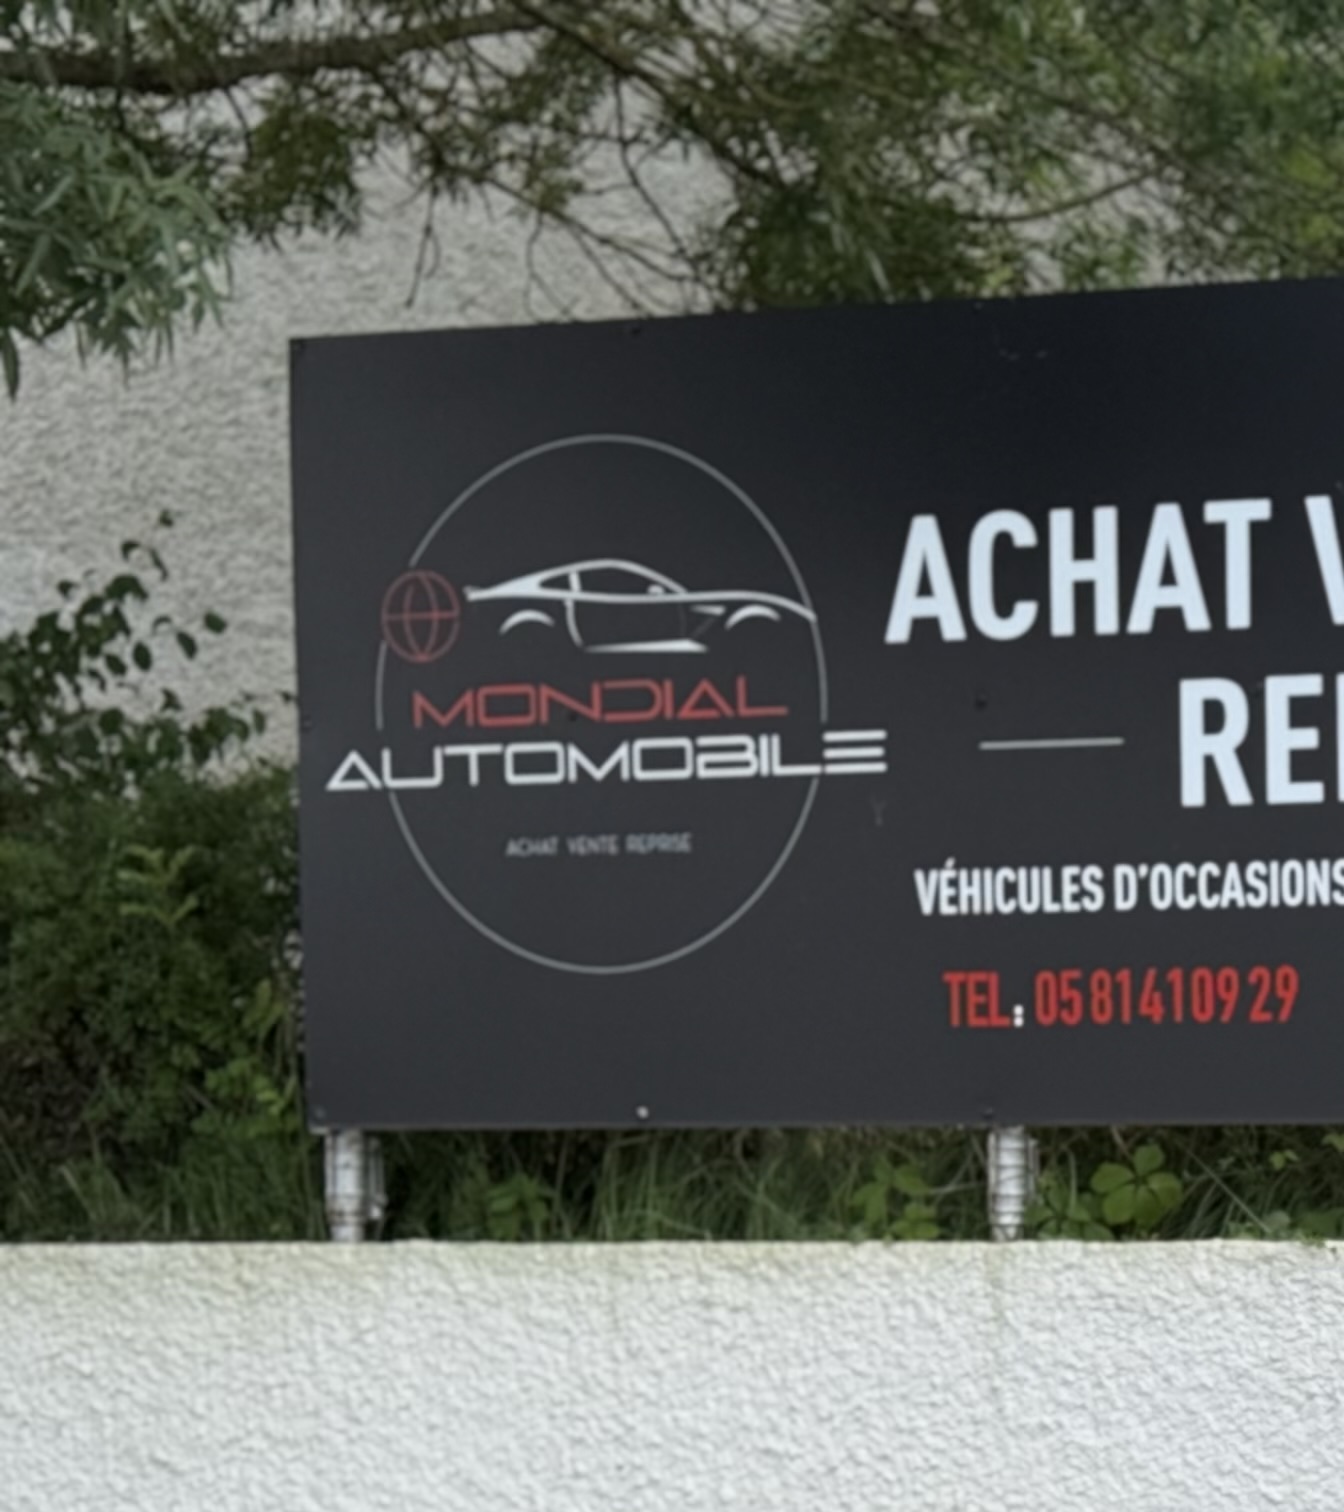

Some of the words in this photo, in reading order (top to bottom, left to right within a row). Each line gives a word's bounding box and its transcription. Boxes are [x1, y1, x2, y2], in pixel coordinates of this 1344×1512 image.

[885, 499, 1271, 643] ACHAT
[412, 675, 789, 729] MONDIAL
[326, 729, 887, 791] AUTOMOBILE
[505, 836, 559, 857] ACHAT
[566, 834, 619, 855] VENTE
[626, 831, 691, 854] REPRISE
[913, 857, 1105, 916] VÉHICULES
